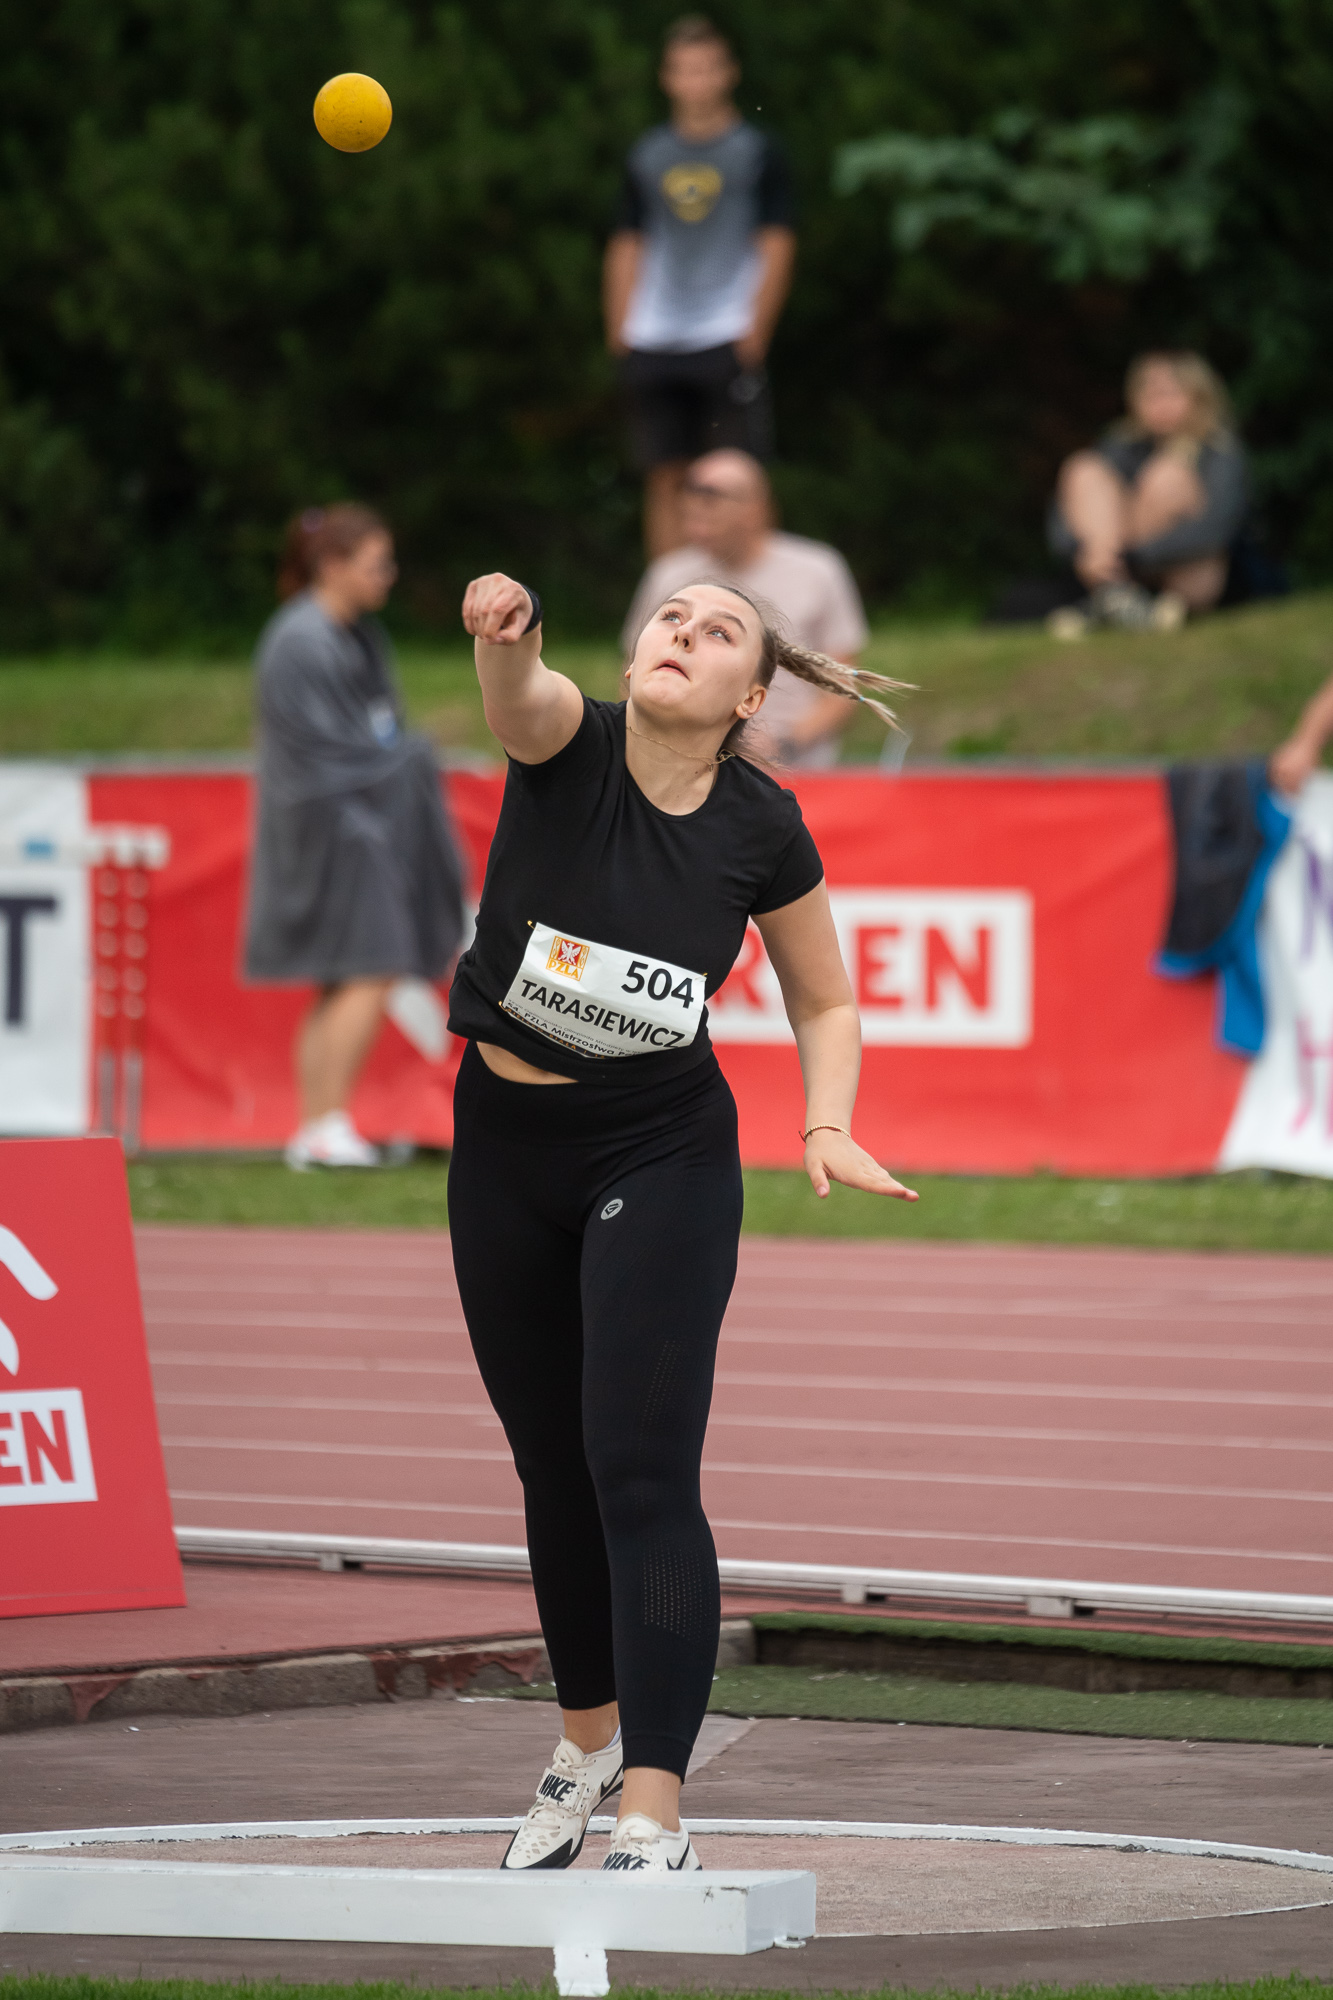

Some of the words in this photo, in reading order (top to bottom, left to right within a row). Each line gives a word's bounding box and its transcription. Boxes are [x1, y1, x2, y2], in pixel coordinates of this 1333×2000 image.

[548, 959, 579, 979] PZLA
[620, 960, 695, 1009] 504
[521, 979, 686, 1049] TARASIEWICZ
[524, 1012, 548, 1029] PZLA
[551, 1027, 615, 1056] Mistrzostwa
[539, 1773, 578, 1803] NIKE
